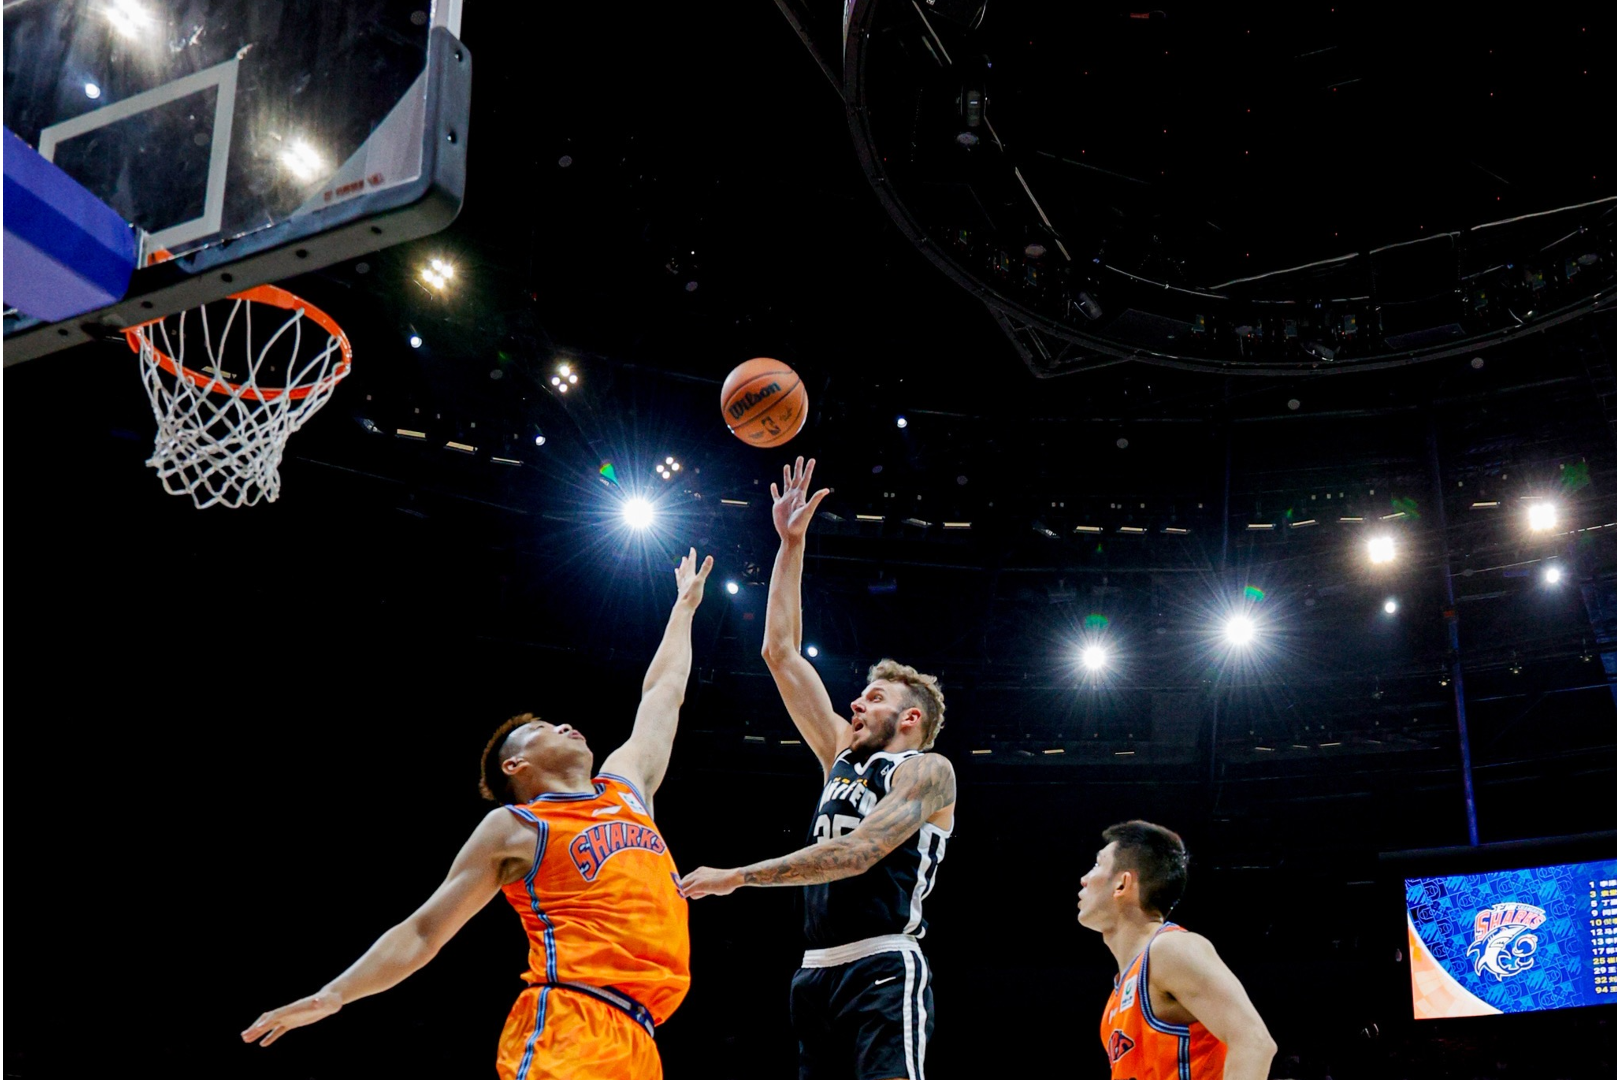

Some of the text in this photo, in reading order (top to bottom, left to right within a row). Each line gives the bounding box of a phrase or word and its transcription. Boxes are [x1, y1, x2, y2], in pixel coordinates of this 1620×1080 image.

[729, 382, 781, 419] Wilson
[569, 820, 667, 882] SHARKS
[1475, 909, 1546, 941] SHARKS
[1590, 928, 1603, 936] 12
[1592, 947, 1605, 955] 17
[1593, 957, 1606, 965] 25
[1593, 966, 1607, 974] 29
[1594, 976, 1607, 984] 32
[1595, 986, 1608, 994] 94
